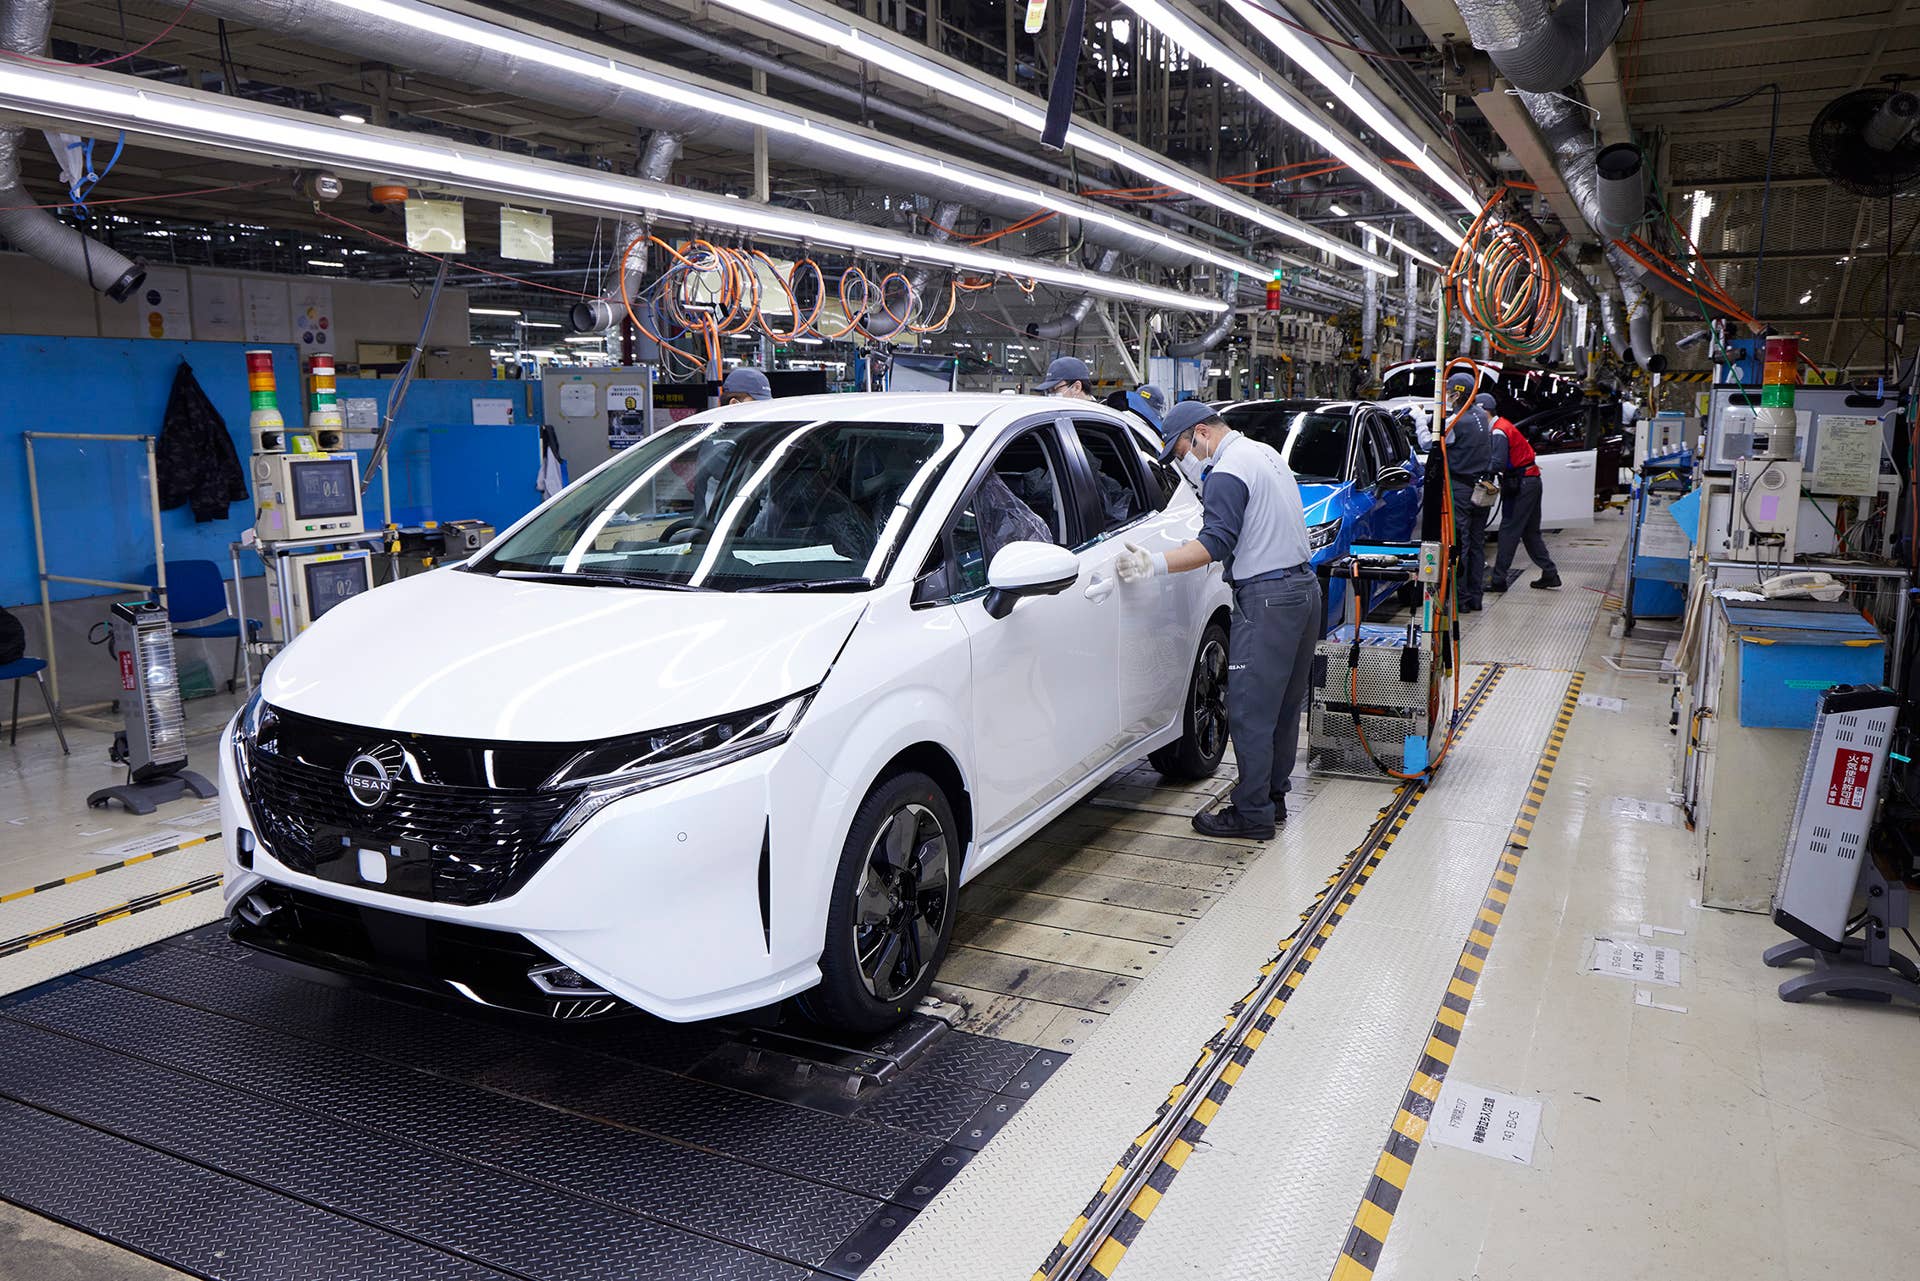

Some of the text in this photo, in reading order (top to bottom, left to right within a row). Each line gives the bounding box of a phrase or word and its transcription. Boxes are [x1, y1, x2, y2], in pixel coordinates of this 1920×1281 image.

[336, 579, 352, 597] 02
[344, 775, 390, 791] NISSAN
[1502, 1110, 1520, 1142] T43 ED-CS
